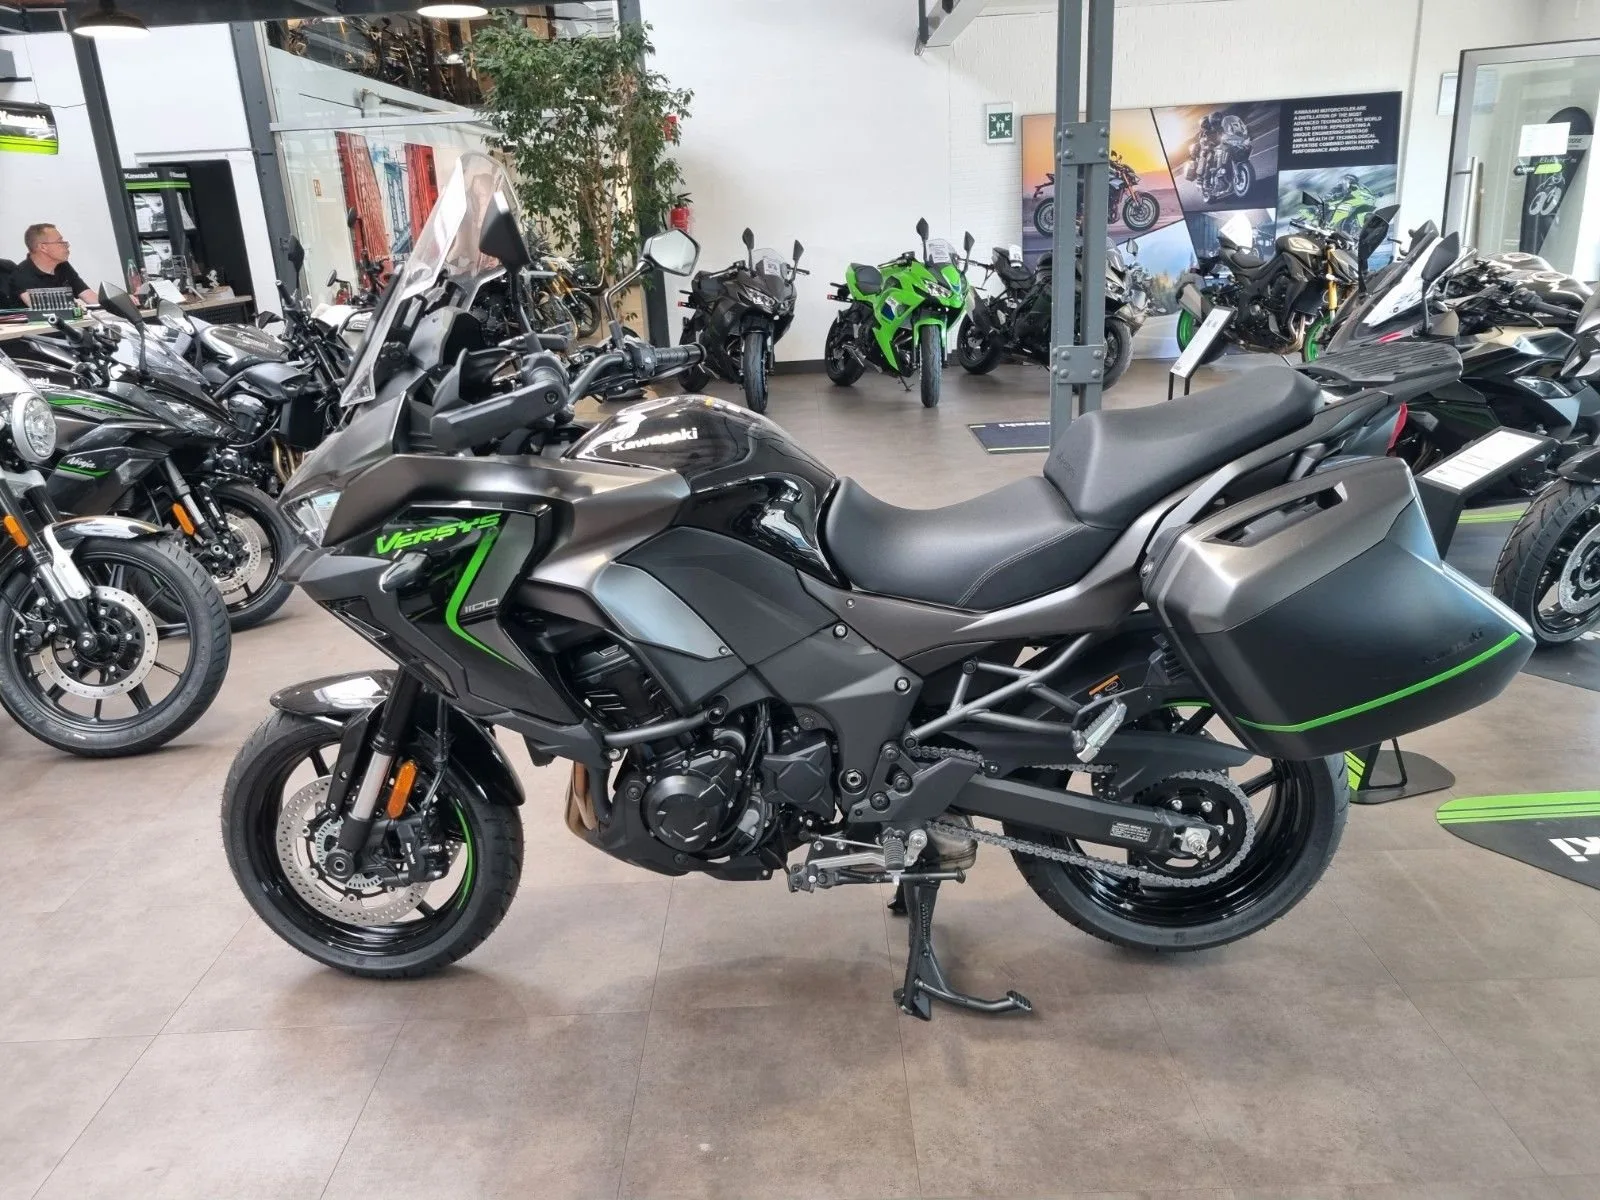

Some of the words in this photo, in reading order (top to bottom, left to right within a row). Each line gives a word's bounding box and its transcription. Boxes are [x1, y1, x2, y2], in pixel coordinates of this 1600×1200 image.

[124, 171, 158, 179] Kawasaki
[611, 426, 698, 453] Kawasaki
[66, 456, 97, 469] Ninja
[376, 512, 502, 554] VERSYS
